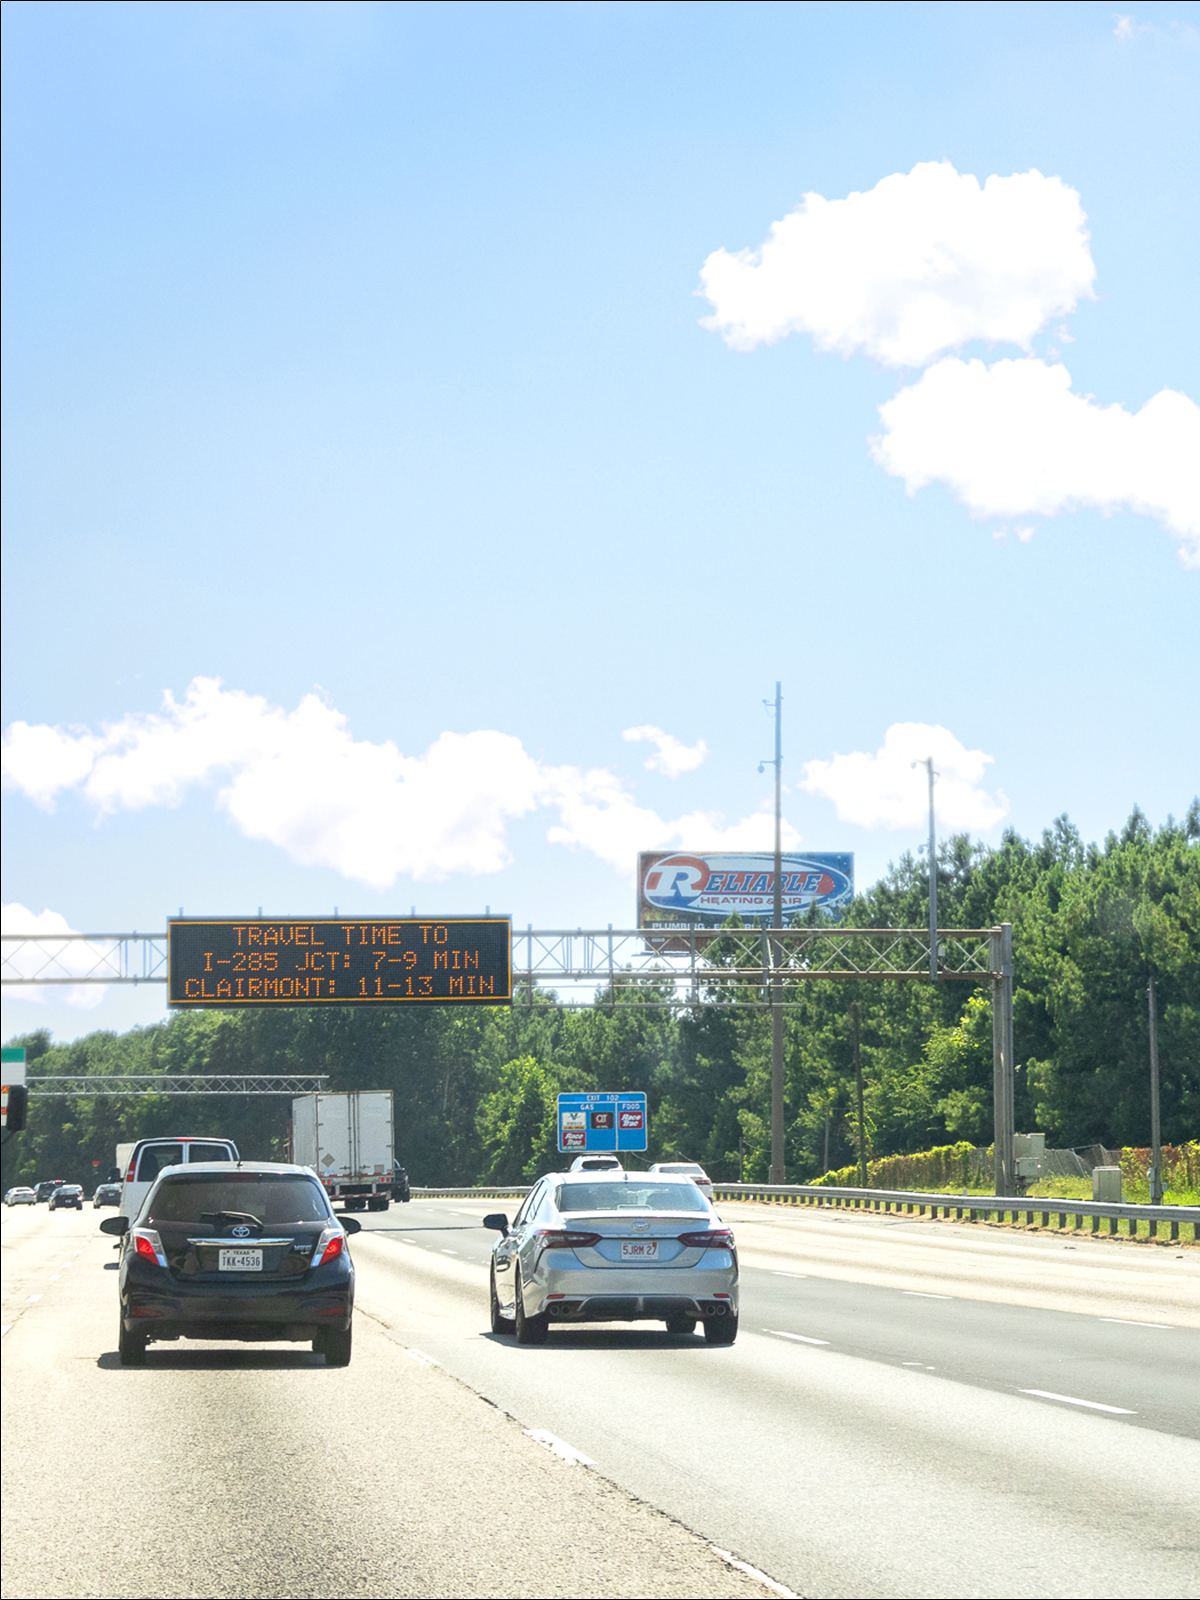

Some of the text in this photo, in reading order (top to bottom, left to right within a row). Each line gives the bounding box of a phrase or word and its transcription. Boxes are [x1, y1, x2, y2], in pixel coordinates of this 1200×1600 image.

[700, 896, 802, 905] HEATING & AIR
[232, 925, 448, 946] TRAVEL TIME TO
[652, 922, 705, 930] PLUMBIG
[203, 950, 479, 972] I-285 JCT: 7-9 MIN
[185, 974, 494, 998] CLAIRMONT: 11-13 MIN
